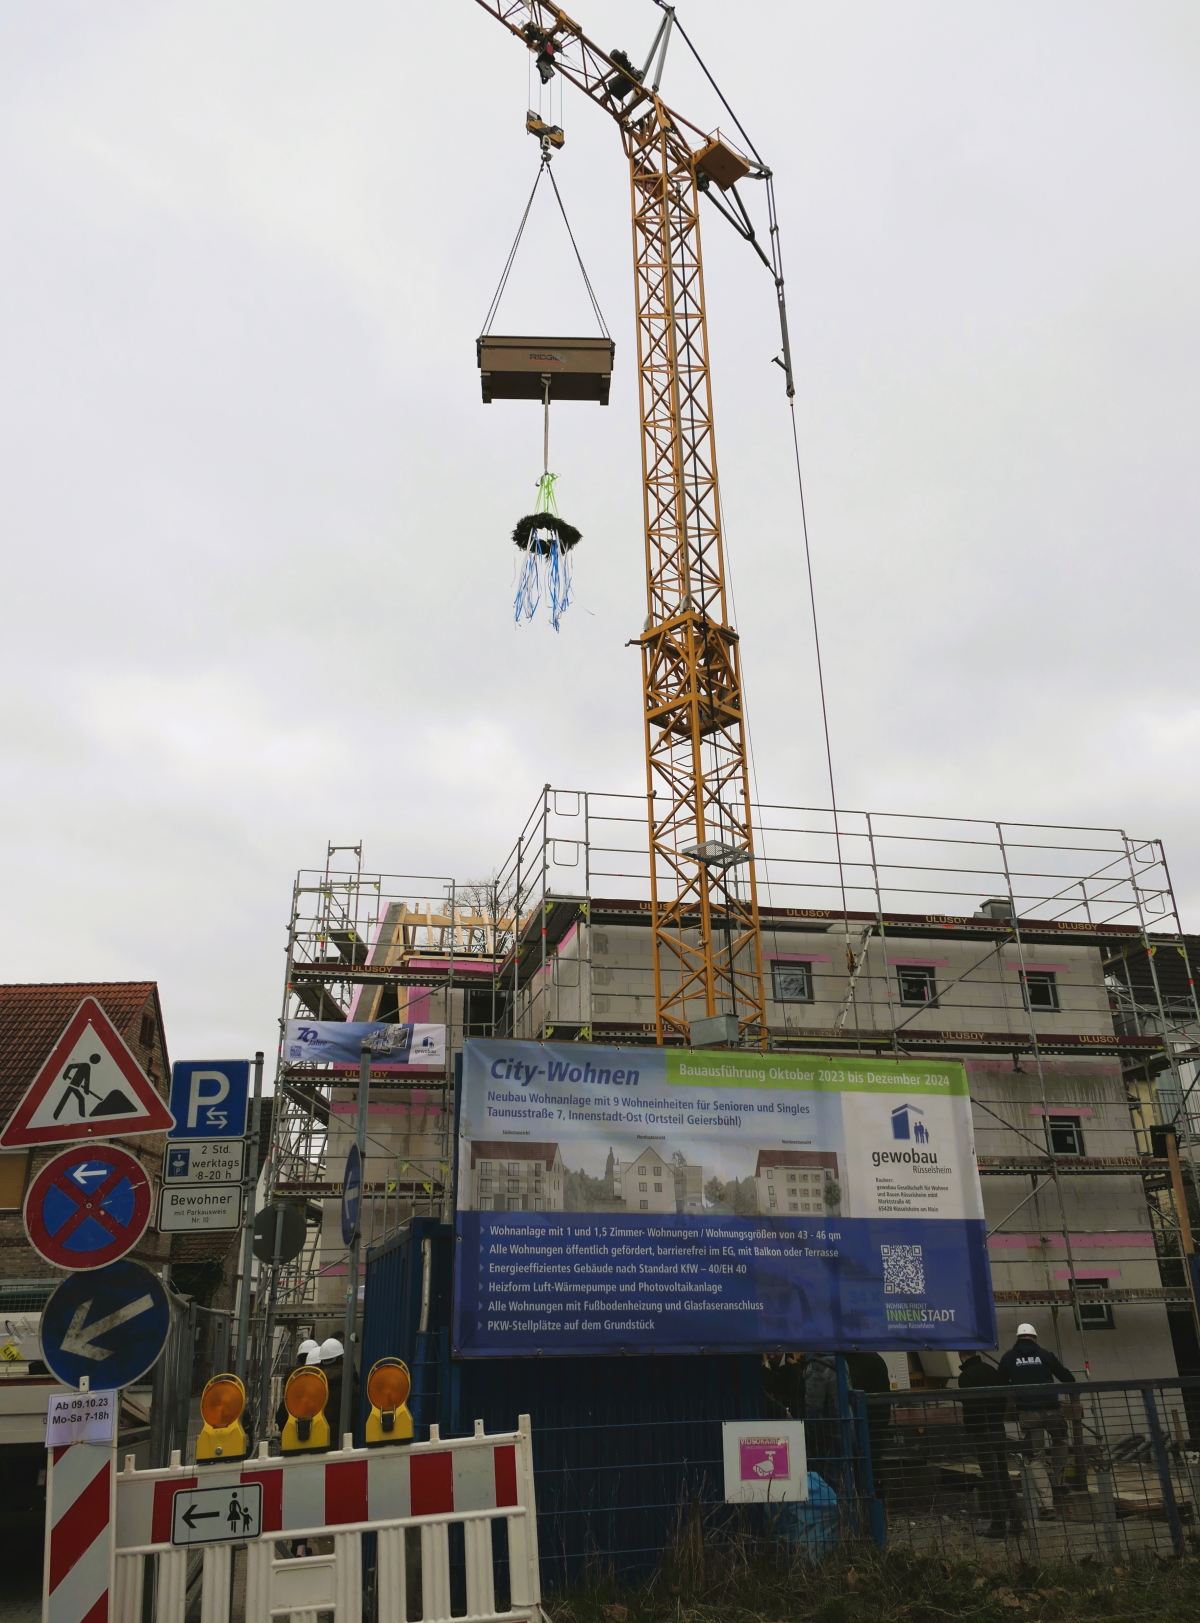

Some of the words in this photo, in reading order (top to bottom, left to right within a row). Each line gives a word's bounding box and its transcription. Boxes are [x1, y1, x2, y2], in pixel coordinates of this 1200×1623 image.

[786, 908, 830, 918] ULUSOY
[926, 916, 967, 924] ULUSOY
[1058, 922, 1097, 931] ULUSOY
[351, 965, 392, 973] ULUSOY
[297, 1028, 318, 1042] 70
[941, 1032, 984, 1040] ULUSOY
[1079, 1035, 1120, 1043] ULUSOY
[491, 1057, 639, 1086] City-Wohnen
[680, 1064, 765, 1081] Bauausführung
[769, 1068, 814, 1080] Oktober
[818, 1070, 844, 1082] 2023
[848, 1072, 864, 1083] bis
[868, 1072, 920, 1085] Dezember
[925, 1074, 950, 1086] 2024
[187, 1071, 230, 1128] P
[488, 1091, 526, 1103] Neubau
[529, 1093, 591, 1107] Wohnanlage
[594, 1096, 610, 1106] mit
[613, 1097, 619, 1106] 9
[621, 1098, 693, 1110] Wohneinheiten
[697, 1099, 710, 1110] für
[714, 1100, 754, 1112] Senioren
[757, 1103, 774, 1113] und
[777, 1103, 810, 1116] Singles
[487, 1107, 553, 1119] Taunusstraße
[557, 1110, 565, 1121] 7,
[569, 1110, 642, 1122] Innenstadt-Ost
[645, 1113, 684, 1125] (Ortsteil
[687, 1115, 742, 1128] Geiersbühl)
[201, 1145, 208, 1155] 2
[213, 1145, 232, 1154] Std.
[192, 1158, 240, 1169] werktags
[872, 1149, 937, 1166] gewobau
[197, 1171, 221, 1181] 8-20
[225, 1170, 232, 1180] h
[912, 1166, 952, 1174] Rüsselsheim
[170, 1193, 233, 1206] Bewohner
[490, 1226, 546, 1238] Wohnanlage
[548, 1227, 564, 1237] mit
[567, 1227, 572, 1237] 1
[574, 1227, 591, 1237] und
[594, 1228, 607, 1239] 1,5
[610, 1228, 645, 1238] Zimmer-
[647, 1228, 699, 1240] Wohnungen
[706, 1229, 777, 1241] Wohnungsgrößen
[798, 1231, 807, 1240] 43
[816, 1231, 826, 1240] 46
[829, 1233, 841, 1241] qm
[490, 1244, 507, 1254] Alle
[510, 1244, 563, 1256] Wohnungen
[566, 1245, 608, 1255] öffentlich
[611, 1245, 655, 1257] gefördert,
[657, 1246, 706, 1256] barrierefrei
[709, 1246, 720, 1256] im
[722, 1247, 735, 1258] EG,
[738, 1247, 752, 1256] mit
[754, 1247, 781, 1256] Balkon
[784, 1247, 802, 1257] oder
[805, 1248, 838, 1257] Terrasse
[489, 1263, 571, 1275] Energieeffizientes
[573, 1262, 613, 1273] Gebäude
[616, 1264, 636, 1273] nach
[639, 1264, 678, 1273] Standard
[681, 1264, 698, 1273] KfW
[708, 1264, 733, 1274] 40/EH
[736, 1265, 747, 1274] 40
[489, 1282, 530, 1292] Heizform
[533, 1282, 616, 1294] Luft-Wärmepumpe
[619, 1282, 636, 1292] und
[638, 1282, 722, 1293] Photovoltaikanlage
[488, 1301, 506, 1311] Alle
[509, 1301, 562, 1313] Wohnungen
[566, 1301, 581, 1311] mit
[584, 1301, 662, 1312] Fußbodenheizung
[665, 1301, 681, 1310] und
[684, 1300, 763, 1310] Glasfaseranschluss
[887, 1310, 955, 1322] INNENSTADT
[488, 1320, 561, 1332] PKW-Stellplätze
[564, 1320, 578, 1330] auf
[581, 1320, 601, 1330] dem
[604, 1320, 655, 1330] Grundstück
[55, 1401, 69, 1411] Ab
[71, 1398, 108, 1409] 09.10.23
[52, 1414, 82, 1425] Mo-Sa
[85, 1411, 109, 1421] 7-18h
